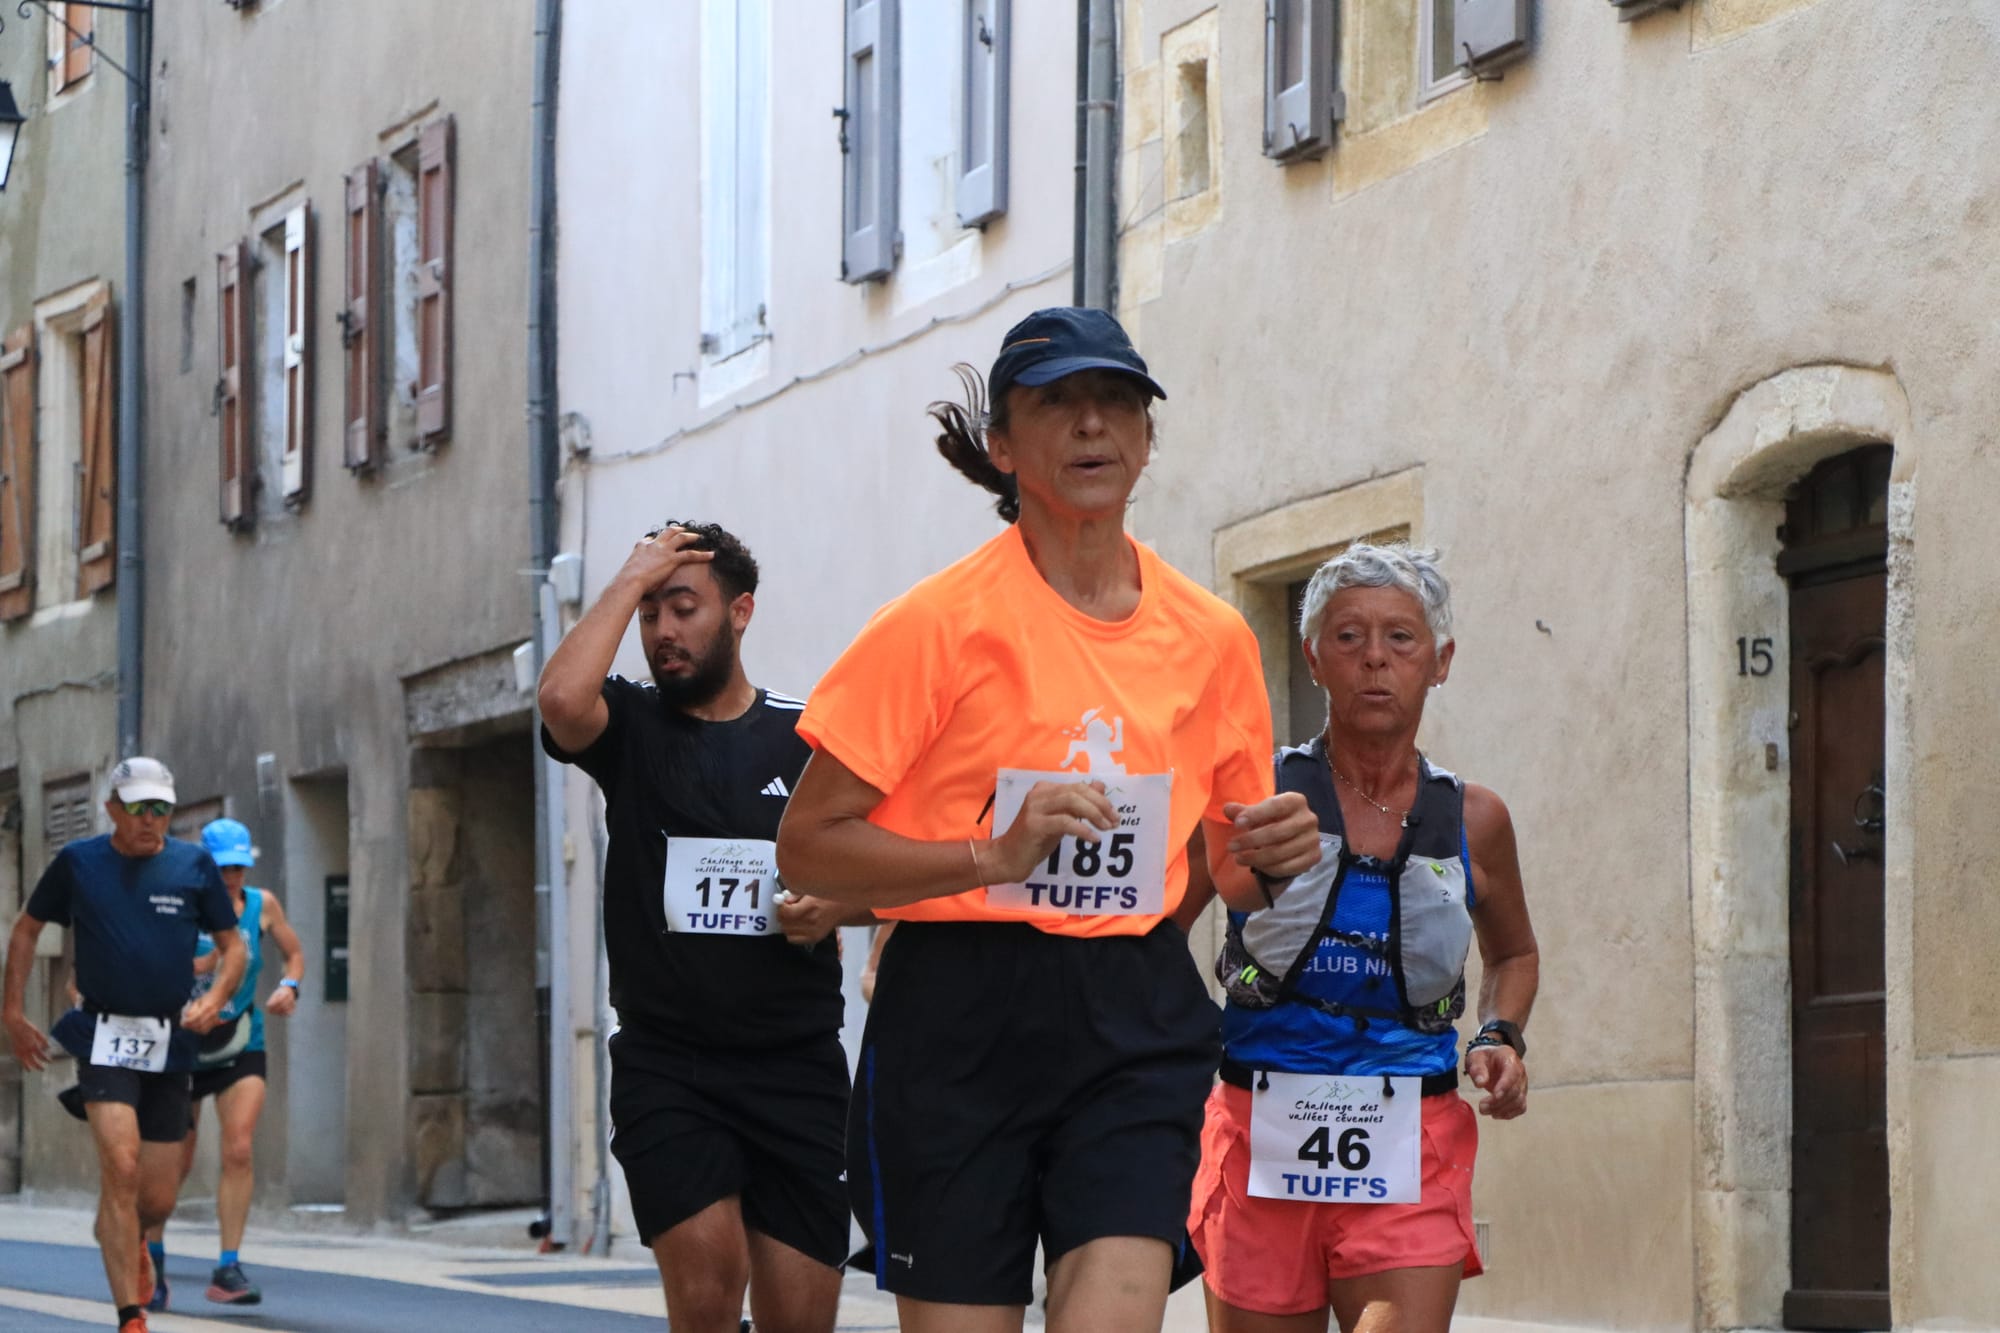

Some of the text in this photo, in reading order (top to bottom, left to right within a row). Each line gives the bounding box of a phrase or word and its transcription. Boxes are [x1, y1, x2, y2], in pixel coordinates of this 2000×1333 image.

[1736, 637, 1773, 677] 15
[700, 857, 743, 868] Challenge
[696, 877, 760, 910] 171
[1025, 883, 1138, 909] TUFF'S
[686, 912, 767, 932] TUFF'S
[1365, 957, 1392, 977] NI
[110, 1037, 156, 1057] 137
[1289, 1112, 1384, 1123] vallées cévenoles
[1295, 1100, 1379, 1115] Challenge des
[1298, 1126, 1371, 1171] 46
[1282, 1173, 1388, 1198] TUFF'S
